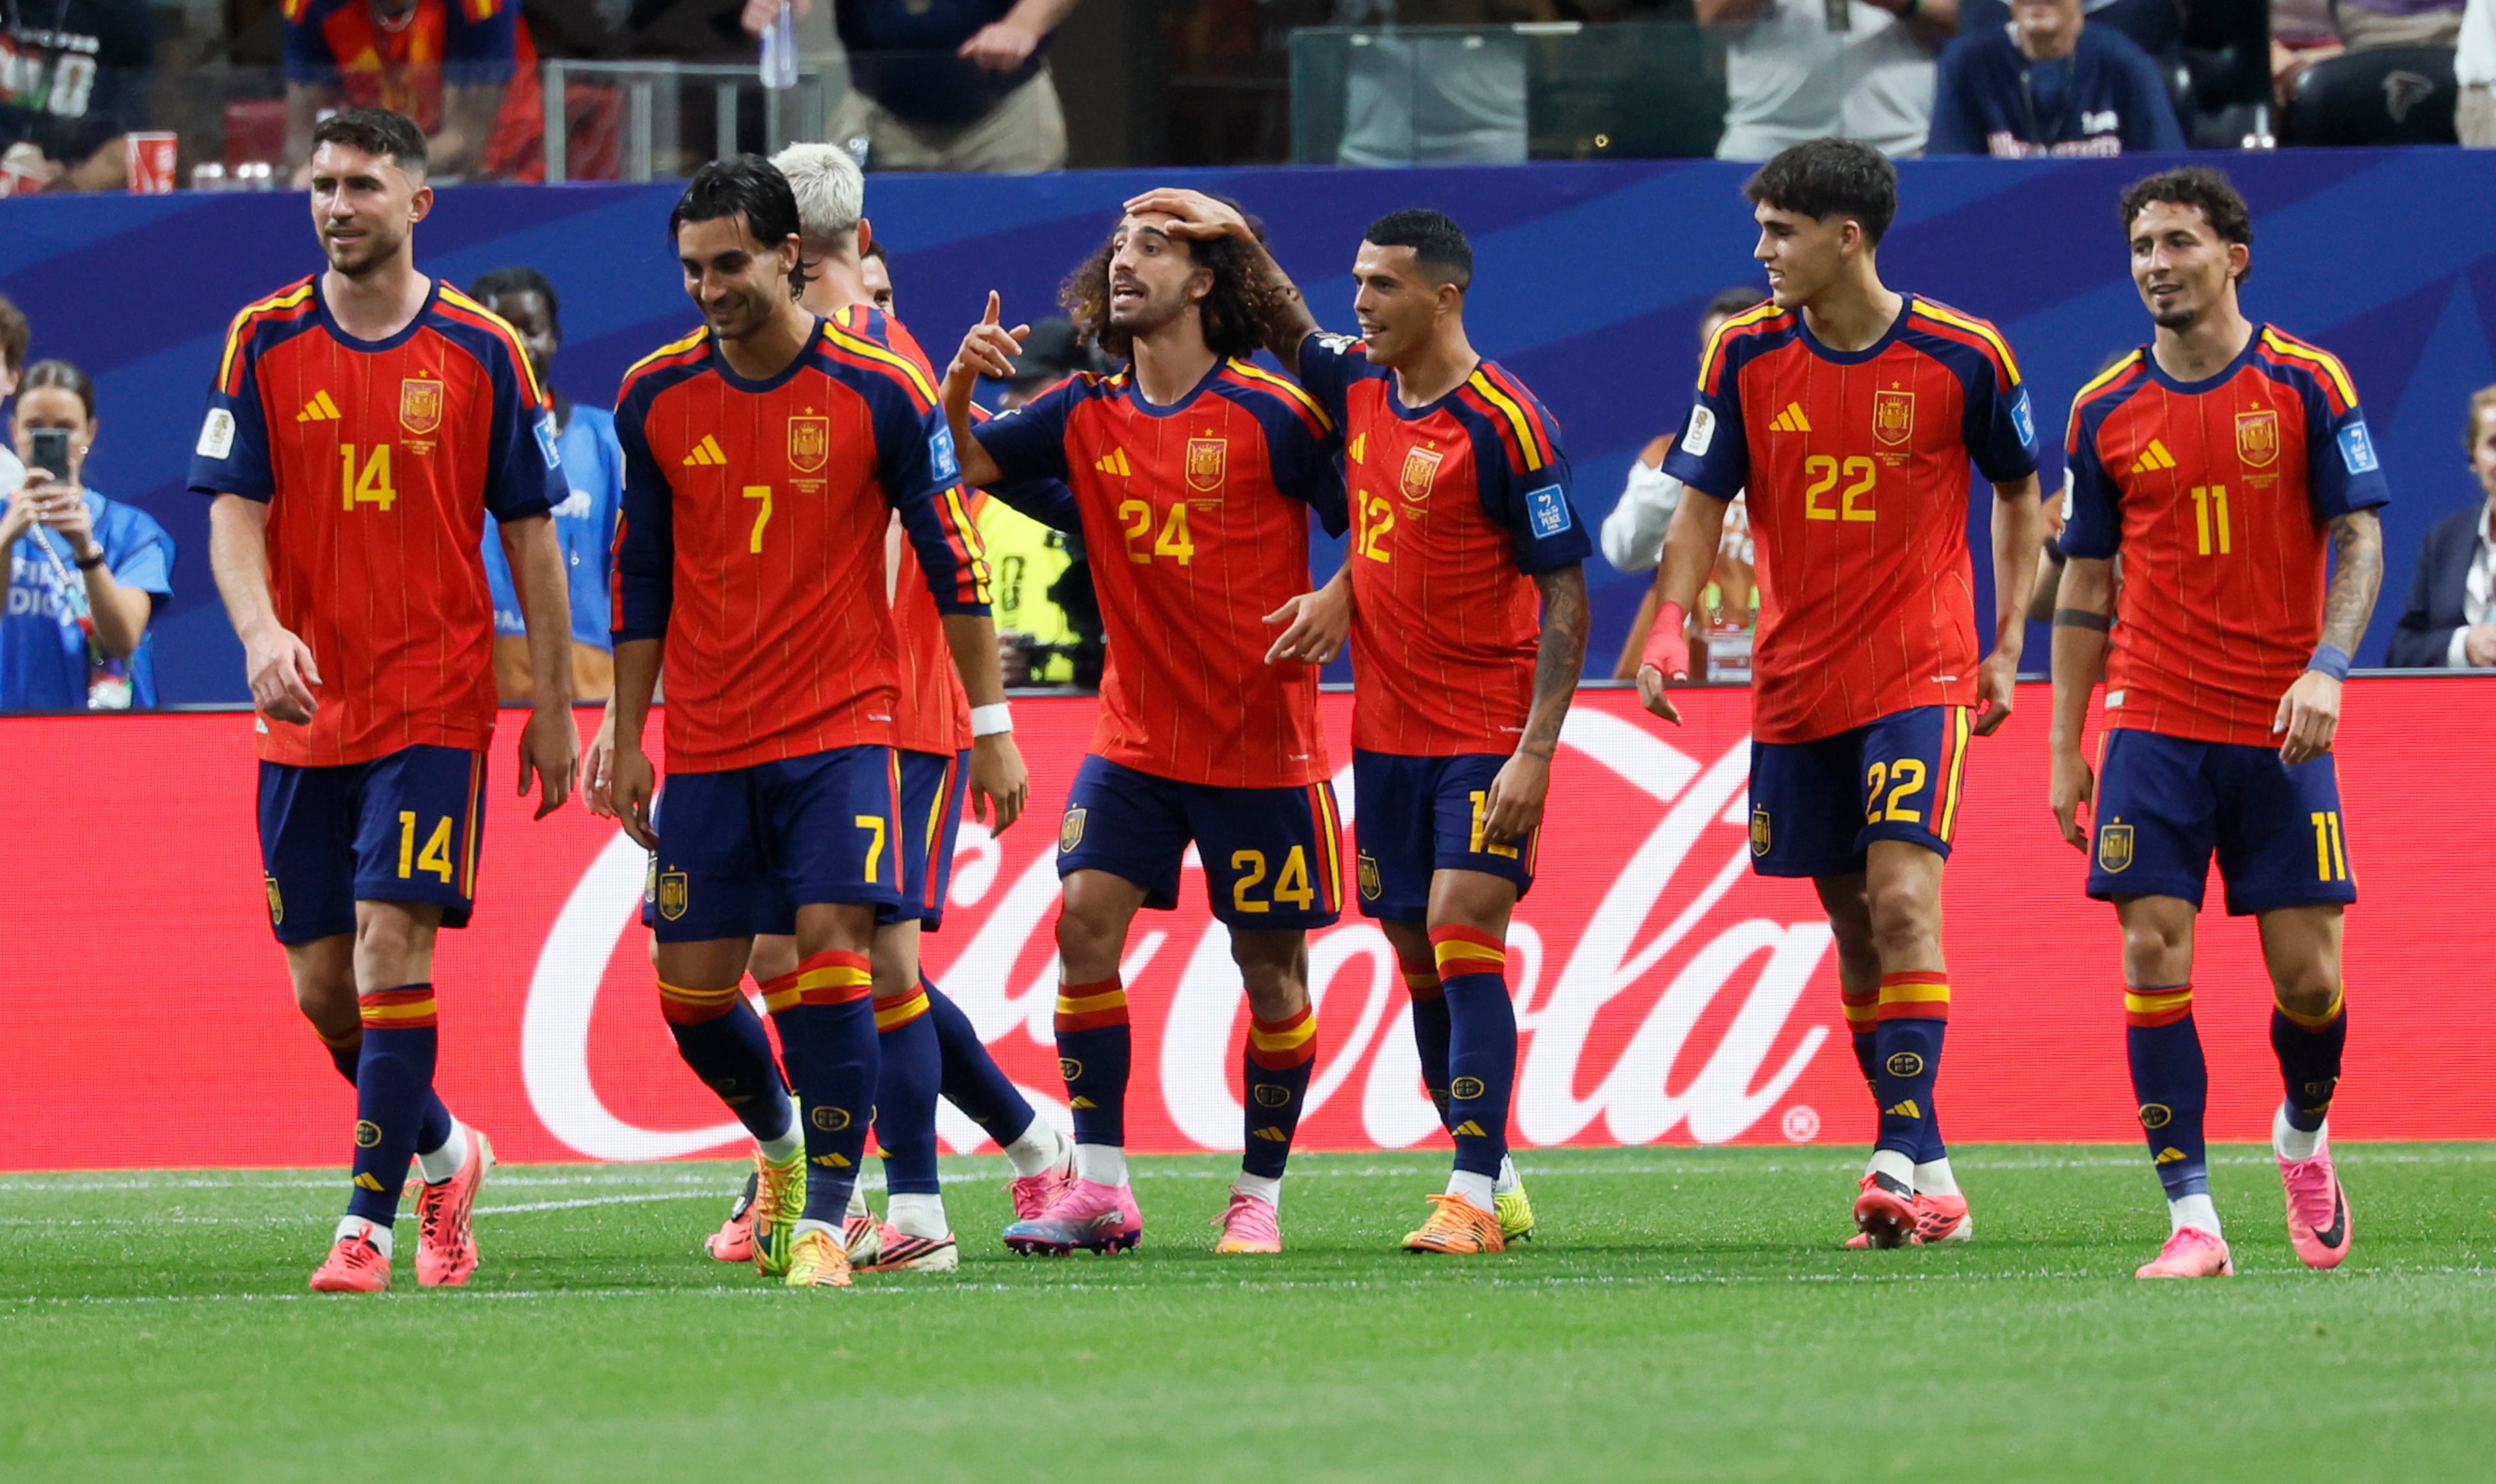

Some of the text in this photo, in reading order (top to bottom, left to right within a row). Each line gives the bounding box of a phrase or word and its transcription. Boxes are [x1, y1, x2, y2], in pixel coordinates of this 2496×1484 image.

[341, 444, 396, 511] 14
[1806, 455, 1877, 521] 22
[743, 486, 772, 553] 7
[1119, 499, 1194, 565] 24
[1358, 490, 1396, 564] 12
[2192, 486, 2230, 554] 11
[1866, 758, 1927, 824] 22
[398, 811, 453, 883] 14
[855, 814, 885, 883] 7
[1231, 845, 1315, 913] 24
[2311, 812, 2346, 881] 11
